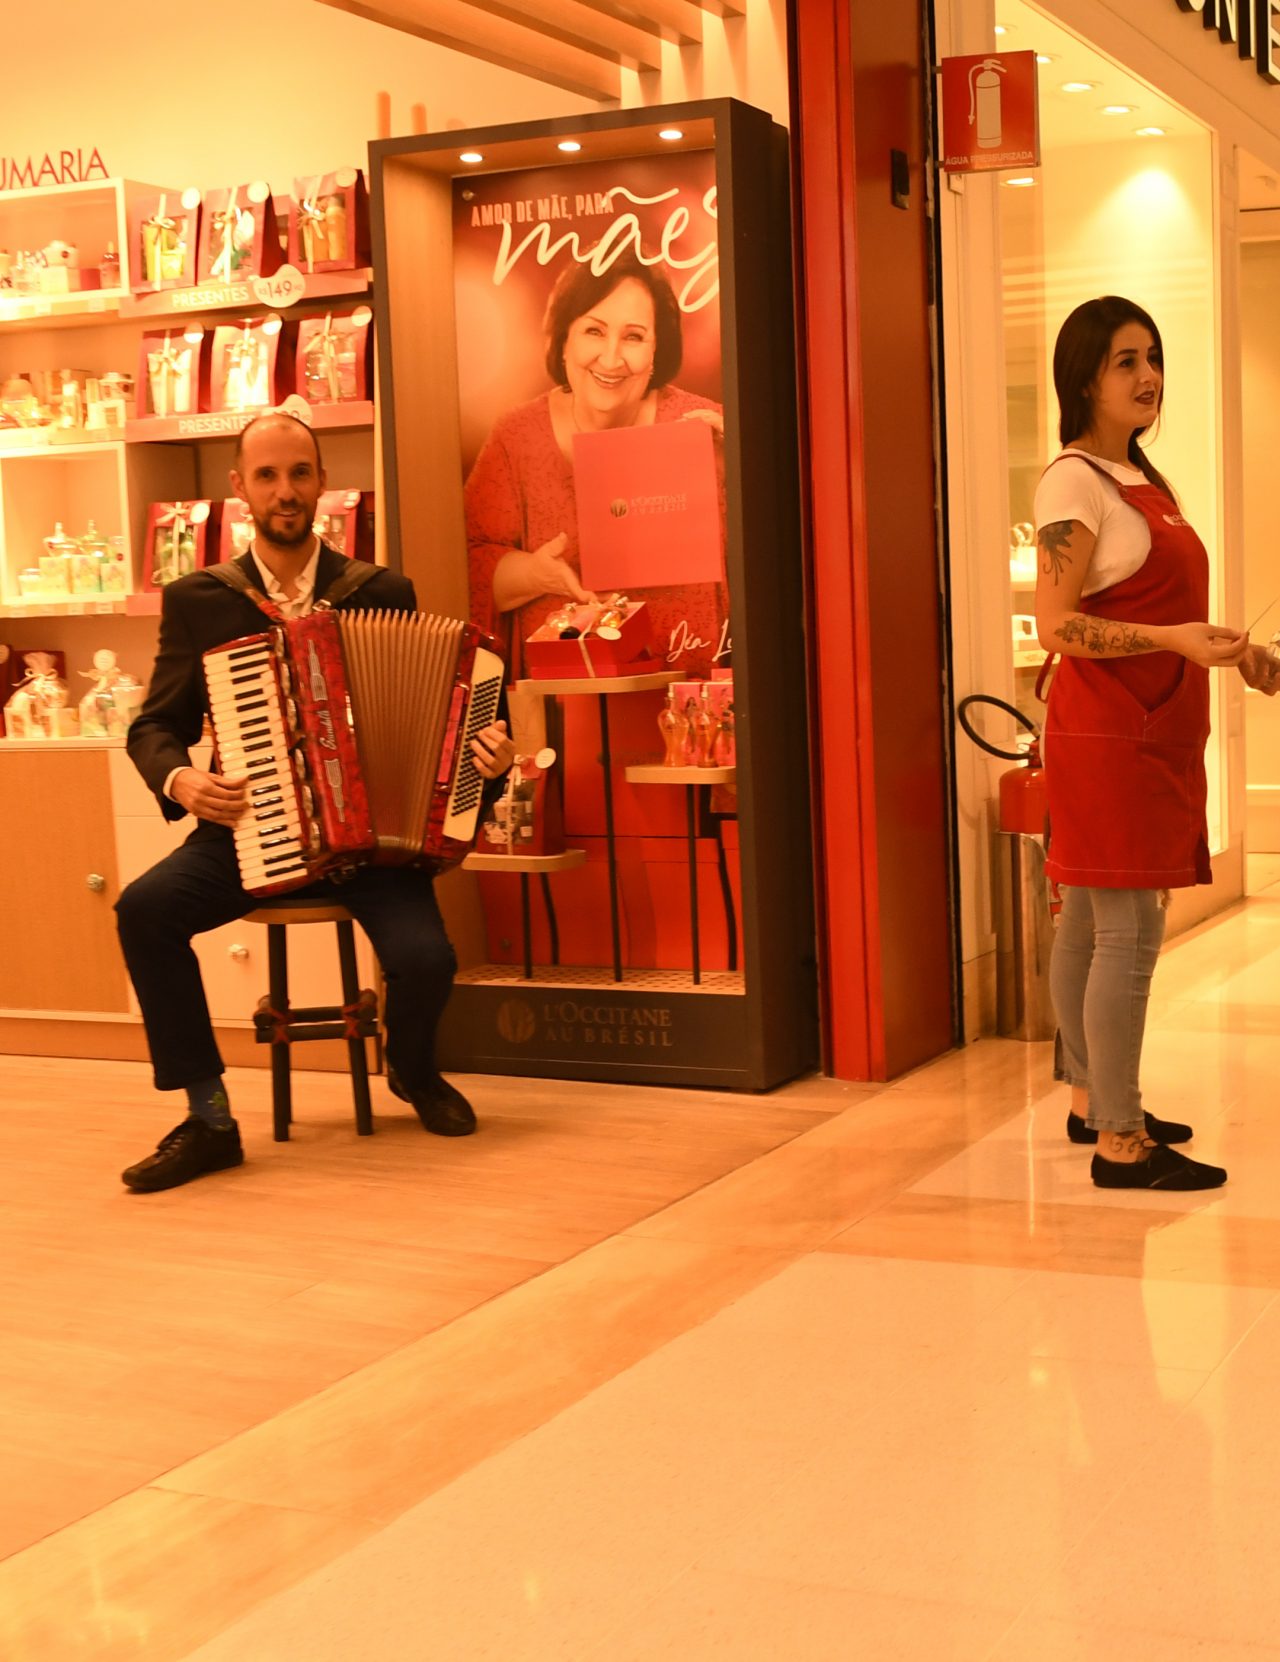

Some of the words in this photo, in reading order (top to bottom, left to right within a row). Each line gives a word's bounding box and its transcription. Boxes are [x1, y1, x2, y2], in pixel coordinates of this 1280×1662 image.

[471, 203, 513, 227] AMOR
[516, 201, 533, 223] DE
[537, 194, 572, 220] MÃE,
[576, 192, 614, 216] PARA
[172, 285, 249, 308] PRESENTES
[267, 280, 292, 298] 149
[545, 1025, 574, 1042] AU
[584, 1026, 673, 1047] BRÉSIL
